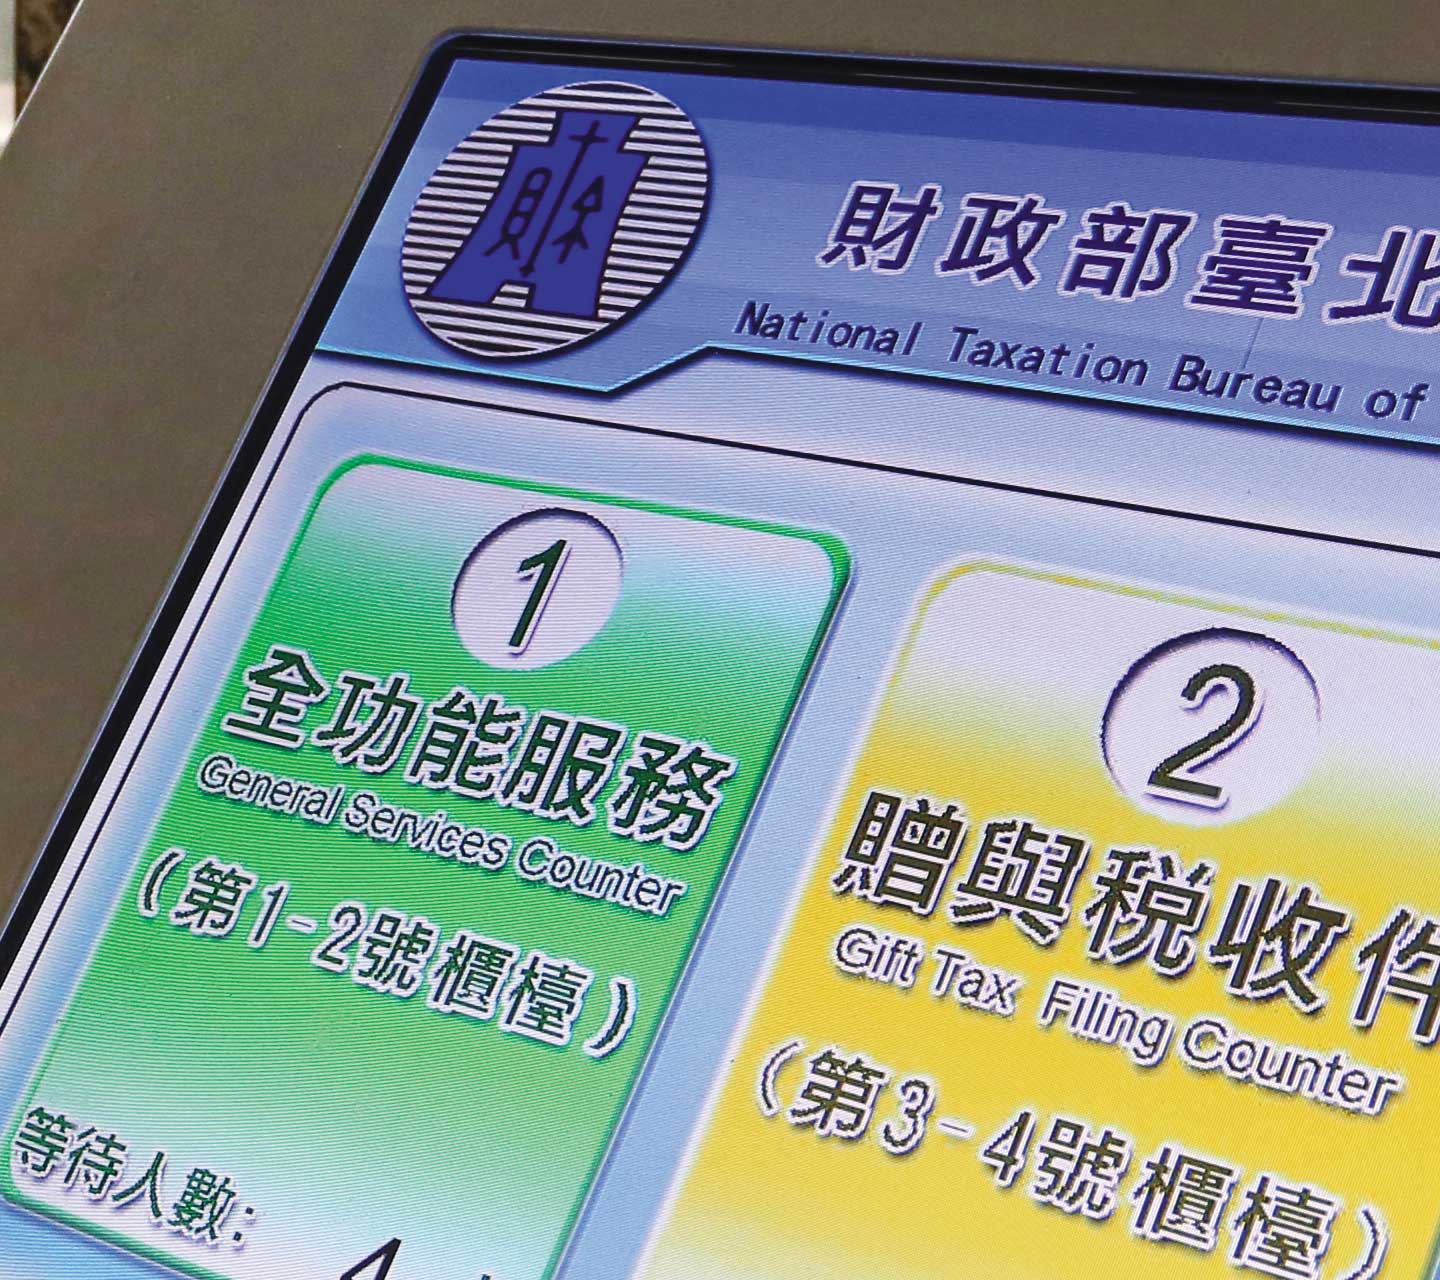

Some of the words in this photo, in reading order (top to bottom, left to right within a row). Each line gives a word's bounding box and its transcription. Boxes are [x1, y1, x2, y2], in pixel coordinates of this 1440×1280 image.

[733, 298, 920, 357] National
[948, 324, 1149, 387] Taxation
[1170, 354, 1342, 413] Bureau
[1364, 381, 1428, 422] of
[515, 537, 570, 652] 1
[222, 646, 736, 852] 全功能服務
[1146, 661, 1262, 810] 2
[199, 754, 343, 824] General
[344, 792, 509, 869] Services
[517, 838, 685, 919] Counter
[833, 926, 920, 990] Gift
[930, 948, 1020, 1016] Tax
[1039, 979, 1172, 1070] Filing
[1181, 1018, 1406, 1120] Counter
